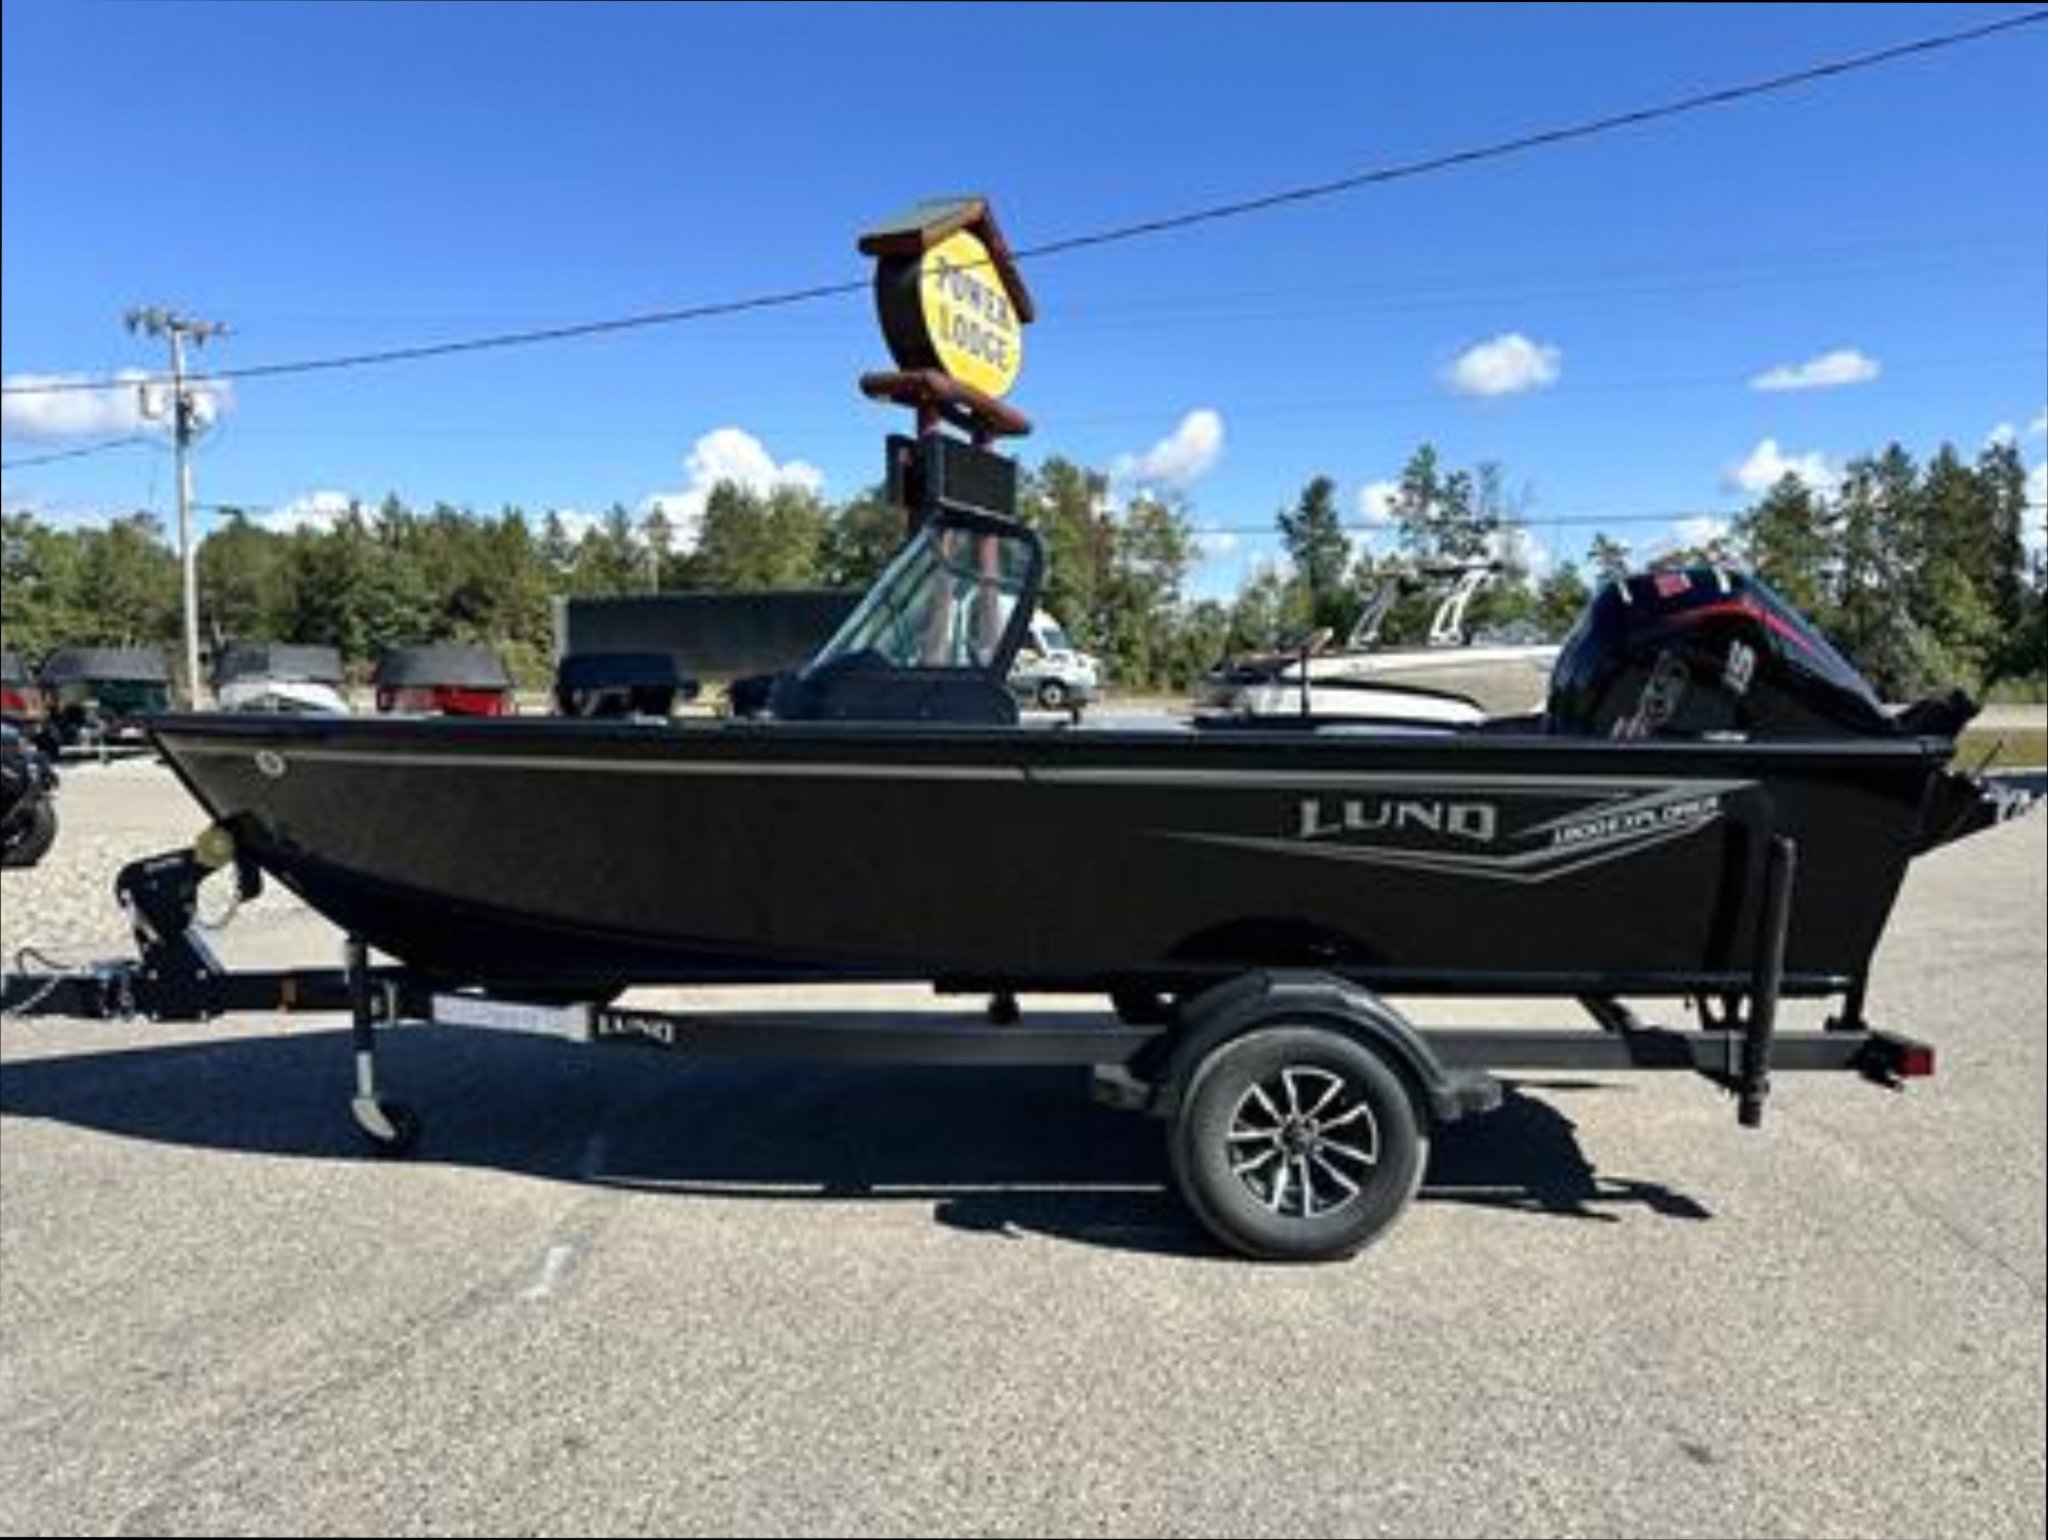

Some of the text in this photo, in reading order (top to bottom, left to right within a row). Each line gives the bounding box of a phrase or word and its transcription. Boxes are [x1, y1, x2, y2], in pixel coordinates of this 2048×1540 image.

[937, 255, 1011, 332] POWER
[939, 303, 1010, 373] LODGE
[1300, 800, 1495, 843] LUND
[599, 1014, 673, 1043] LUND
